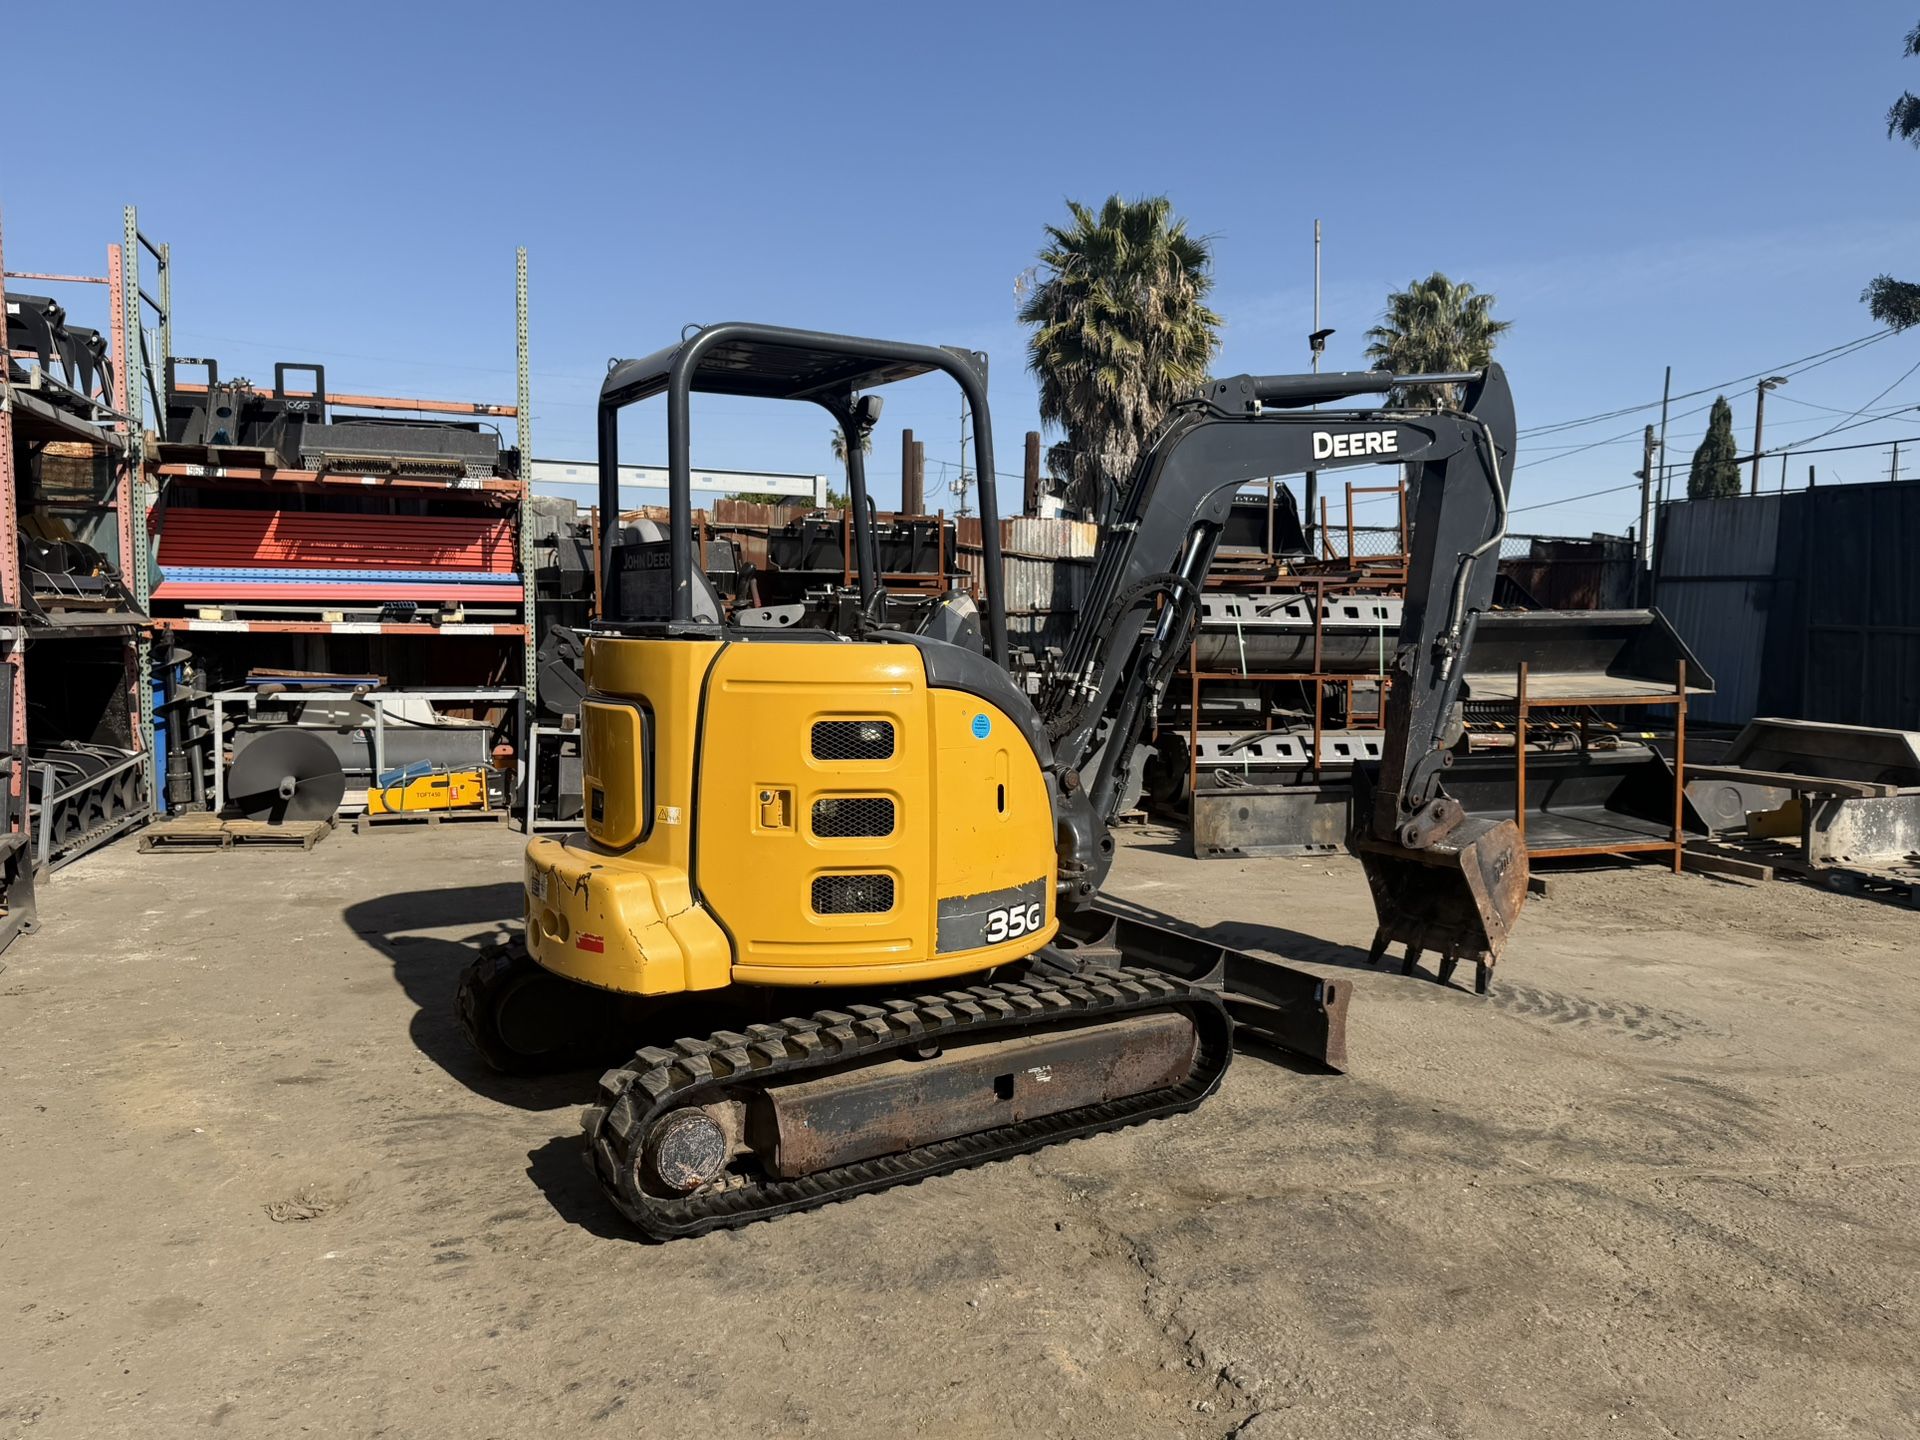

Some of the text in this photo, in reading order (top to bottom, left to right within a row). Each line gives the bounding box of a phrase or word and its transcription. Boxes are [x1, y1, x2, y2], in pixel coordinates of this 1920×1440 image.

[1313, 430, 1398, 460] DEERE
[624, 551, 671, 569] JOHN DEER
[987, 902, 1040, 943] 35G
